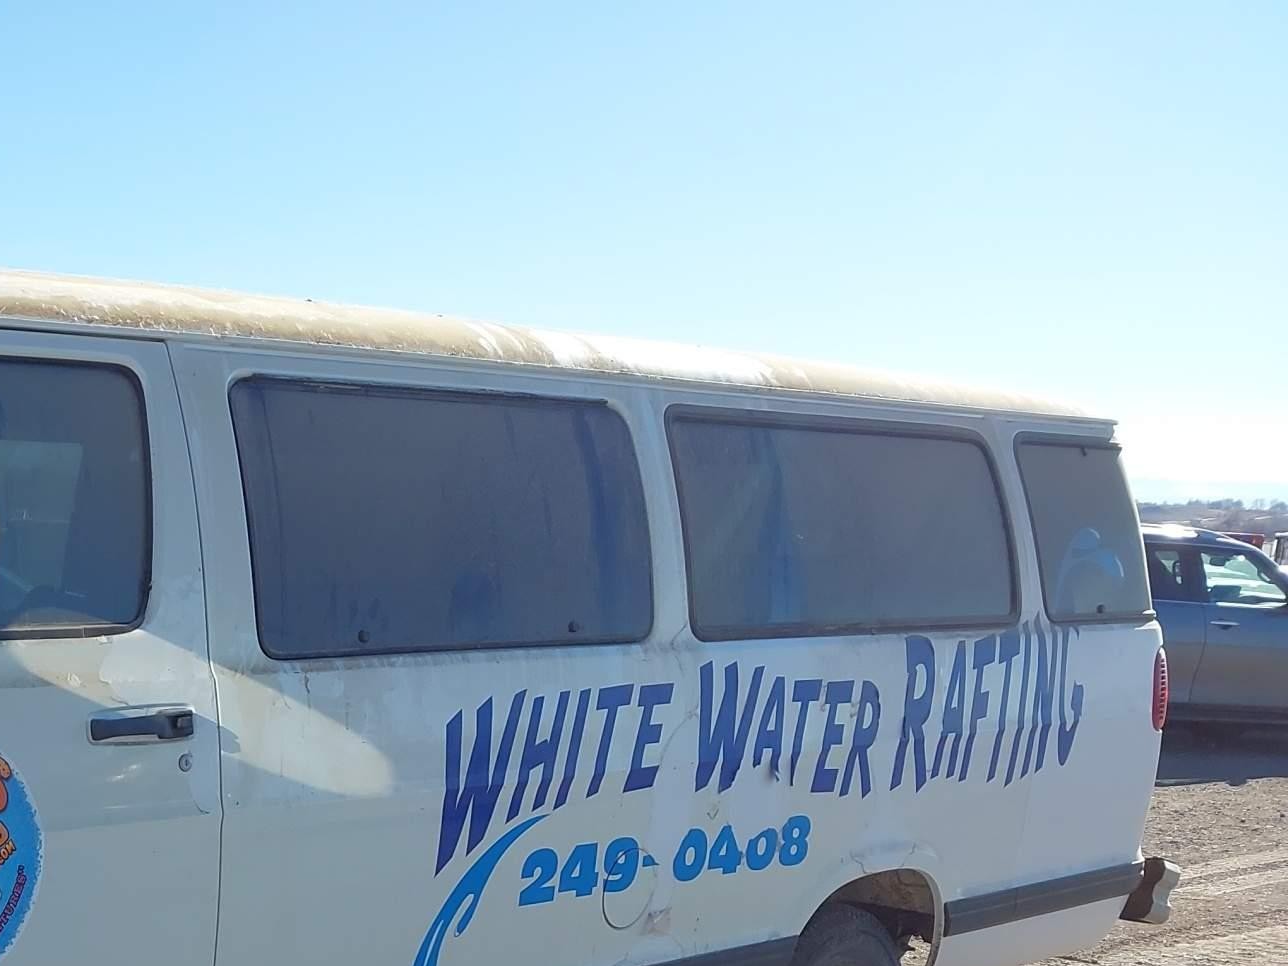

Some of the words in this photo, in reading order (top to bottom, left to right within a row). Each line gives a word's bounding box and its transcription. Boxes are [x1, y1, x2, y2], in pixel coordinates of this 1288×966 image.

[434, 682, 674, 876] WHITE
[694, 659, 882, 798] WATER
[889, 612, 1084, 792] RAFTING
